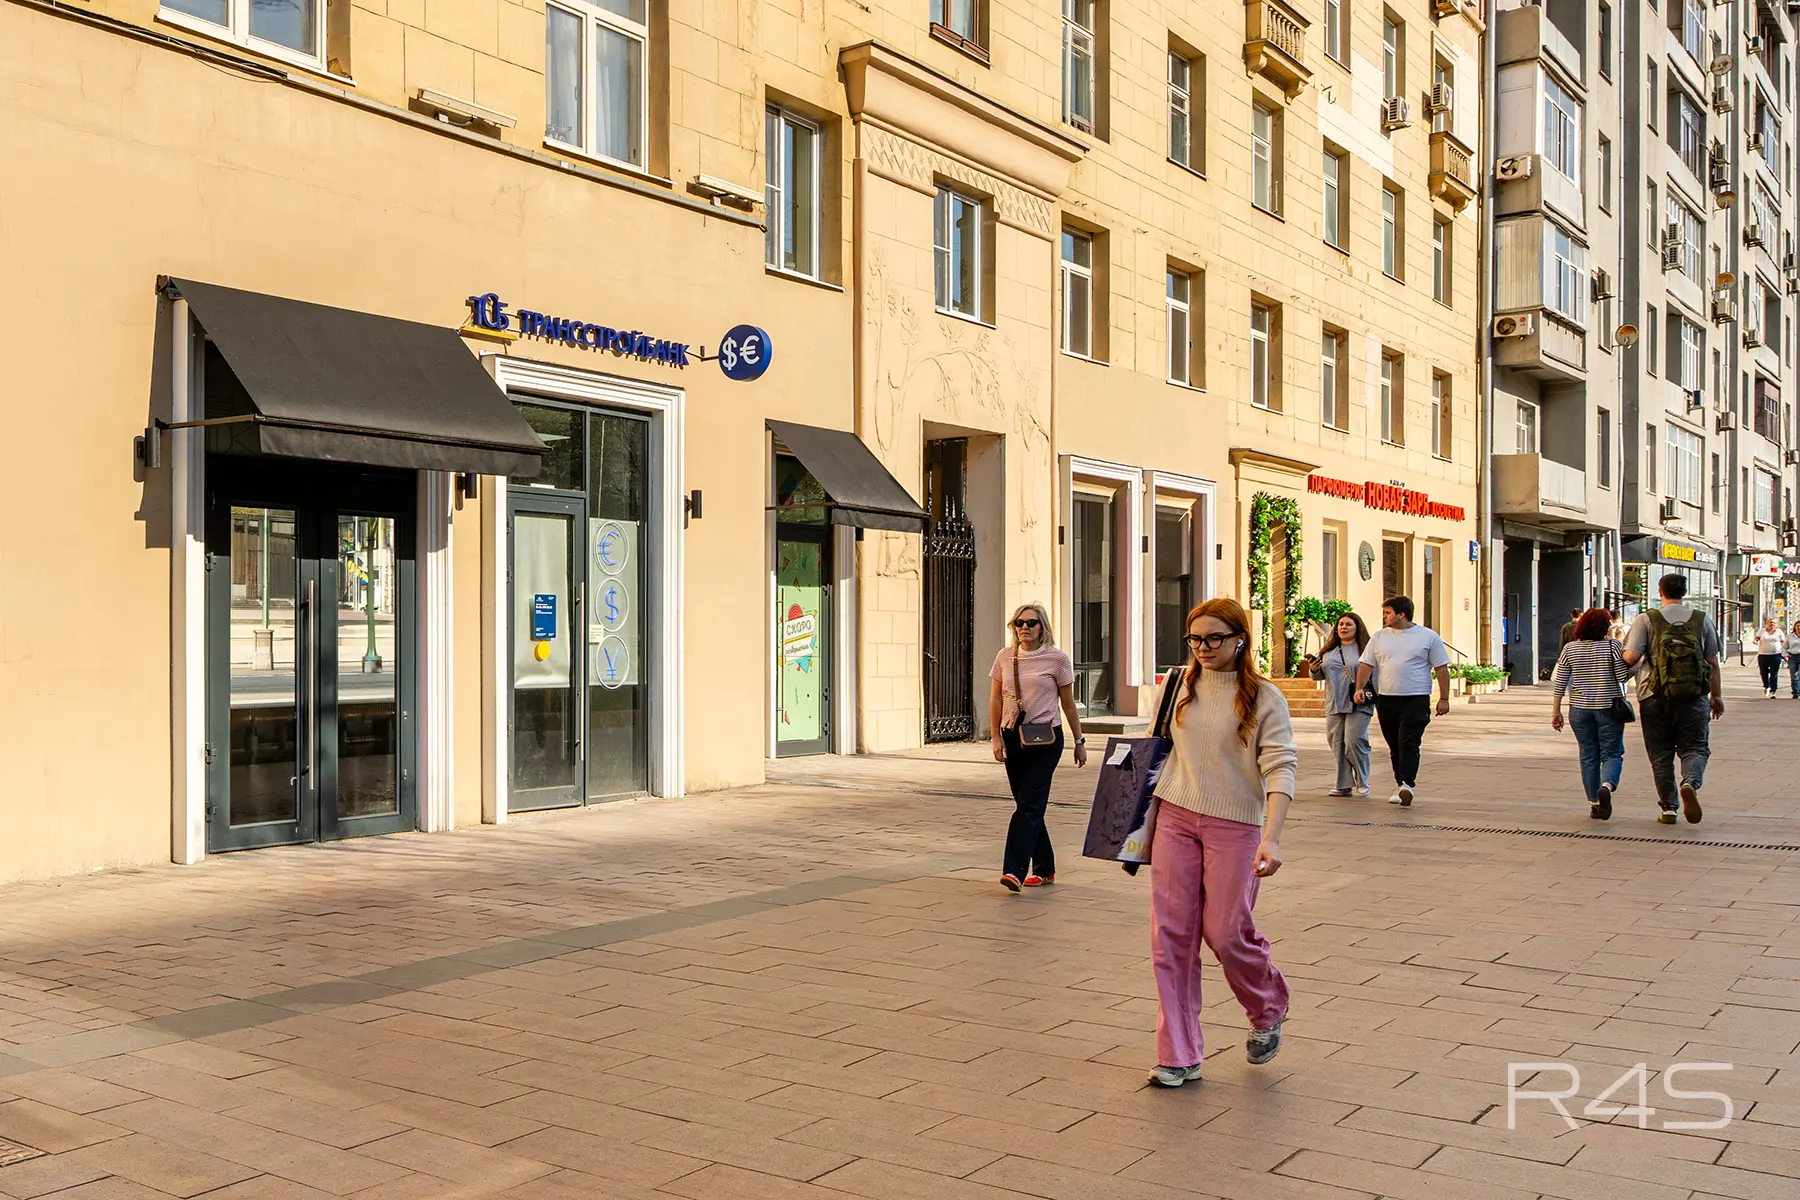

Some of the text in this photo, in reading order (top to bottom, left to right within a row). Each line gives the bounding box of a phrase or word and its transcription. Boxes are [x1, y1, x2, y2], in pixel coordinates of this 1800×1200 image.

[517, 309, 690, 367] ТРАНССТРОЙБАНК
[1308, 474, 1465, 521] ПАРФЮМЕРИЯ НОВАЯ ЗАРЯ КОСМЕТИКА
[787, 620, 811, 635] СКОРО
